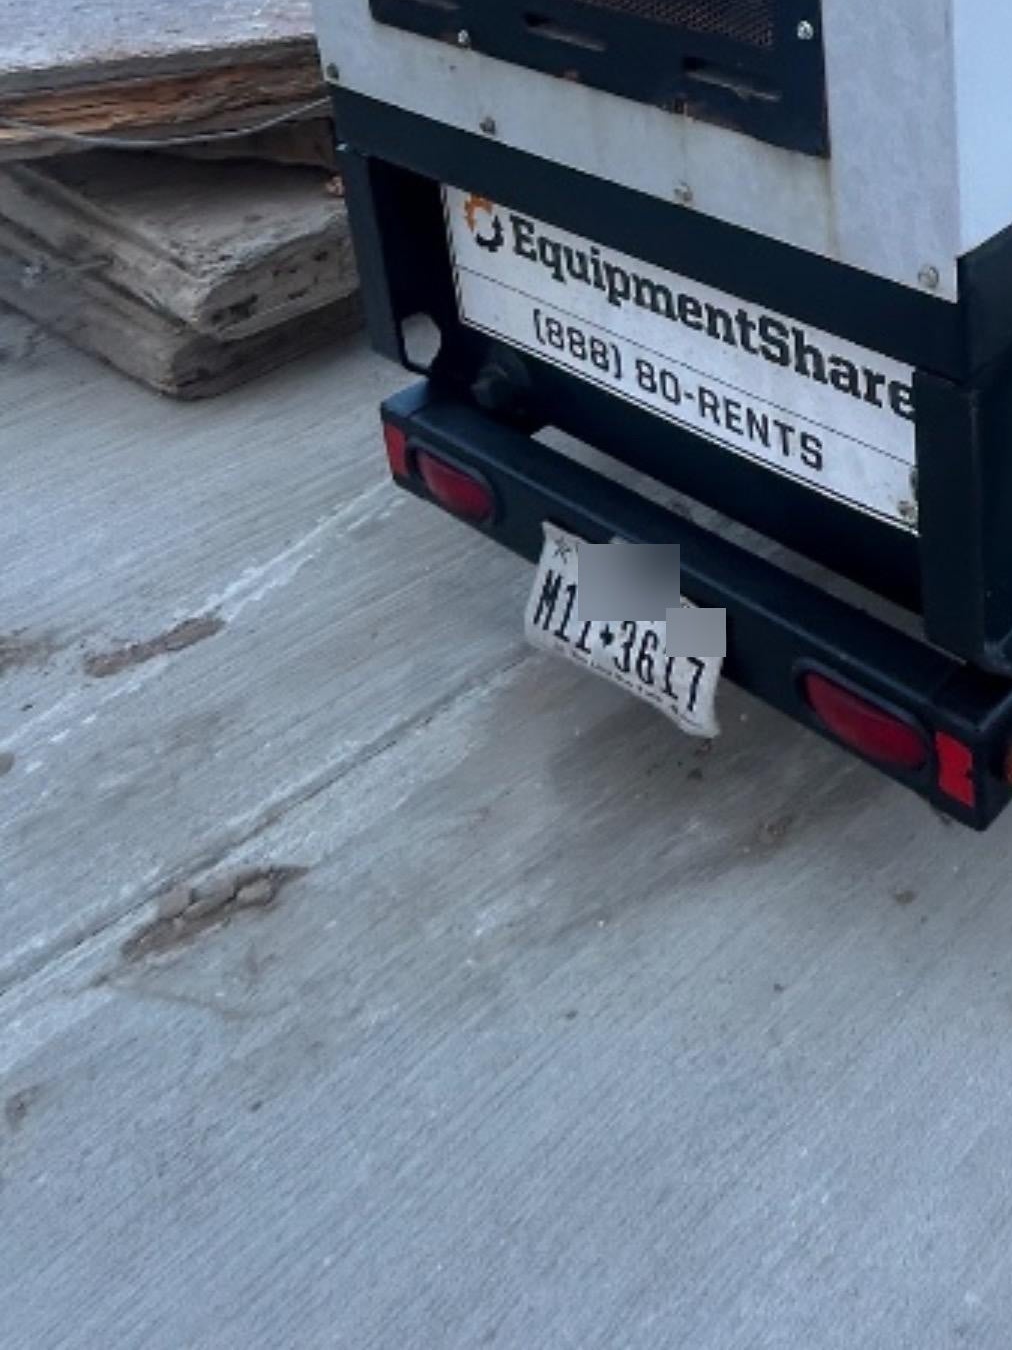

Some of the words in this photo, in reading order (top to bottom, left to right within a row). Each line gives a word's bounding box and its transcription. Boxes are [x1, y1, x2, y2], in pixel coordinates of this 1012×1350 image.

[511, 214, 914, 420] EquipmentShare
[533, 307, 624, 380] (888)
[635, 356, 825, 472] 80-RENTS
